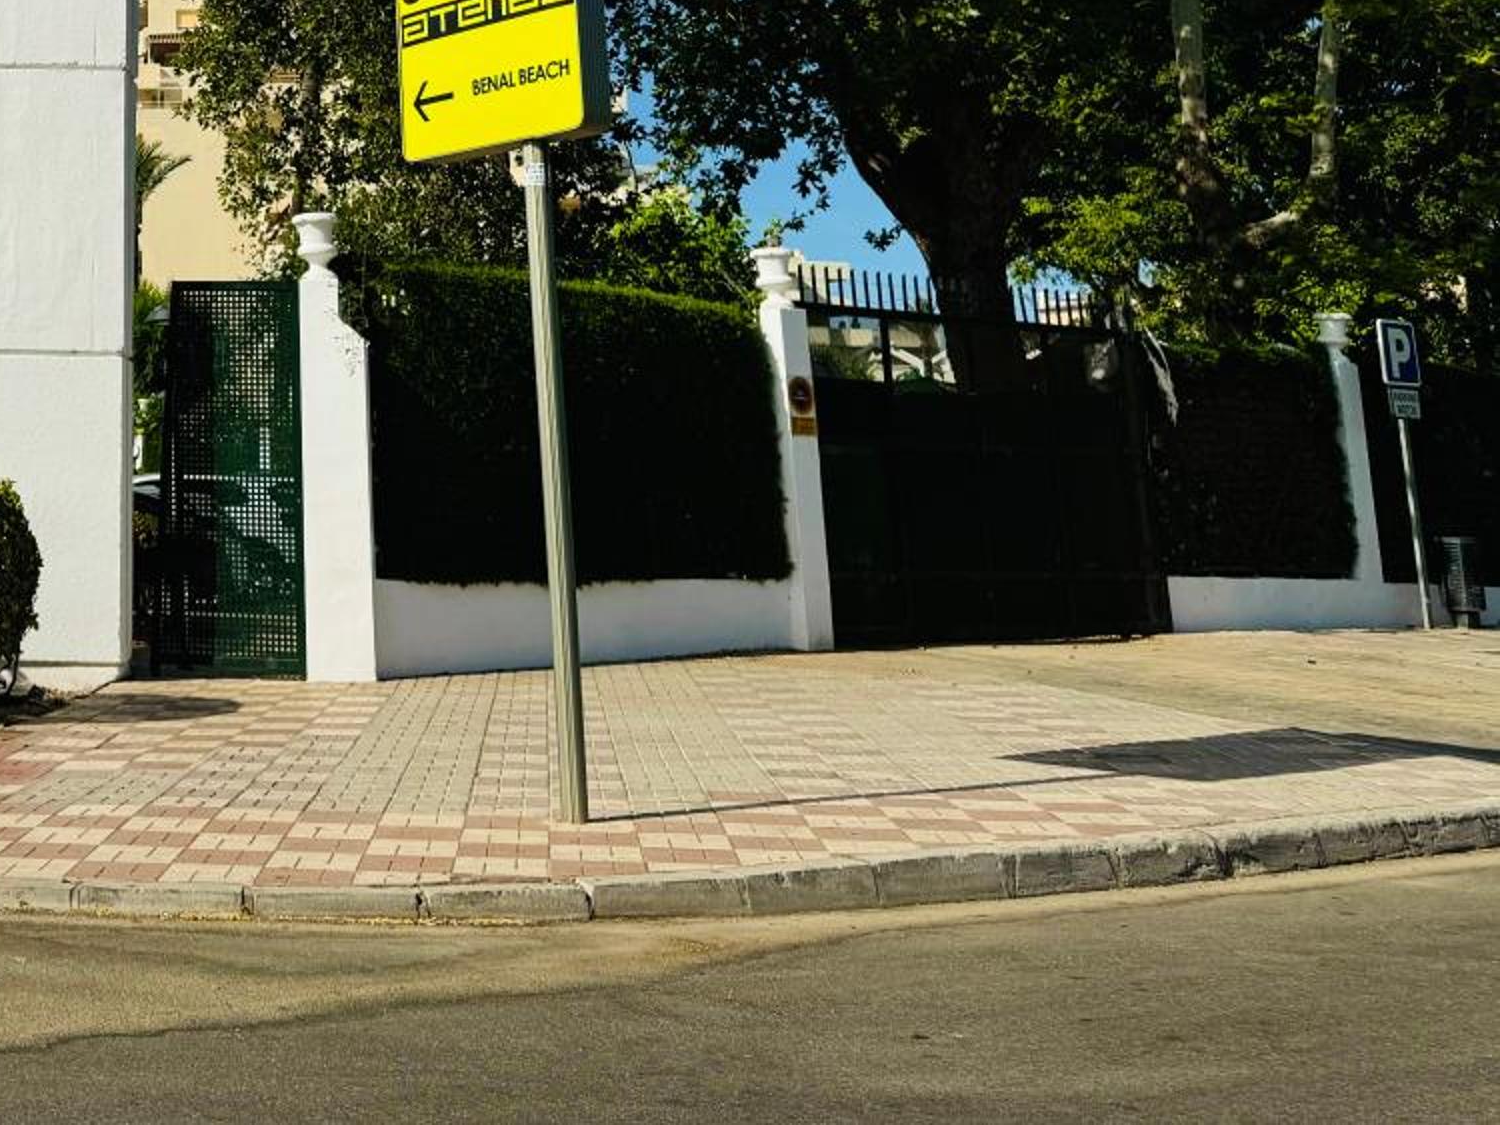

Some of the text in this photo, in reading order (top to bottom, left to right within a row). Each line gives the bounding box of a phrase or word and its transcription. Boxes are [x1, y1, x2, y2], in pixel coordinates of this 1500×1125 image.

[471, 59, 570, 97] BENAL BEACH
[1387, 328, 1412, 378] P
